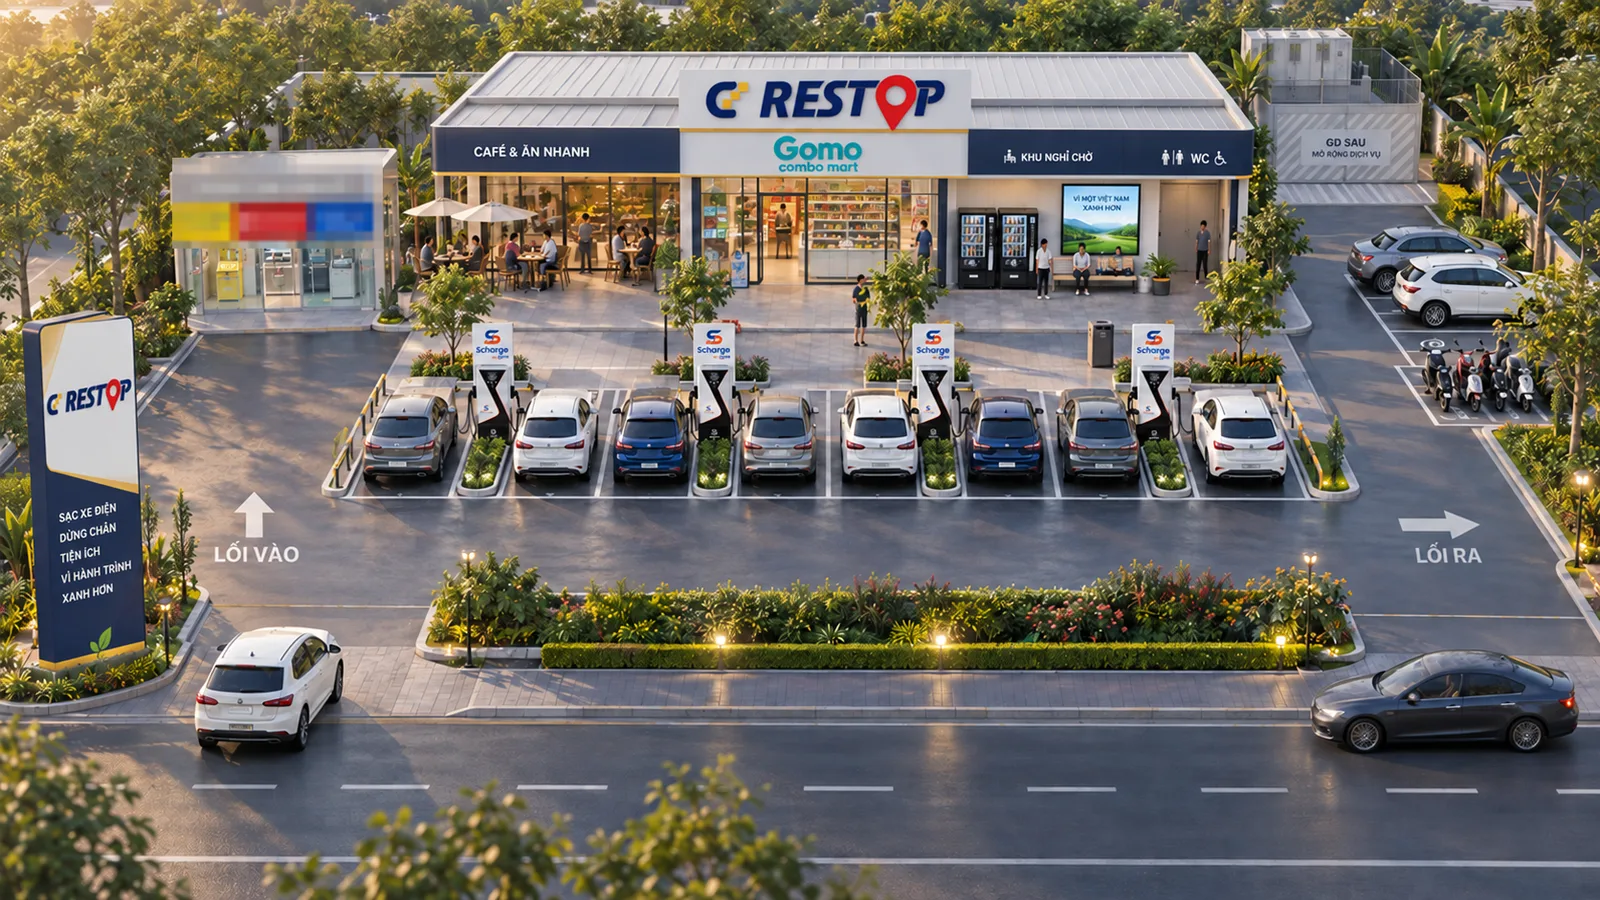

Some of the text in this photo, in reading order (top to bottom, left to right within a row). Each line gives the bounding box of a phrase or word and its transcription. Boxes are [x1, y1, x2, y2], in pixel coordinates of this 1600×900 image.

[760, 75, 945, 131] RESTOP
[474, 144, 590, 157] CAFÉ & ĂN NHANH
[773, 135, 862, 161] Gomo
[1326, 138, 1366, 147] GD SAU
[1021, 153, 1042, 162] KHU
[1071, 150, 1093, 162] CHỜ
[1190, 153, 1210, 164] WC
[1370, 151, 1381, 159] VỤ
[778, 162, 858, 172] combo mart
[65, 378, 132, 412] RESTOP
[59, 502, 117, 523] SẠC XE ĐIỆN
[59, 522, 117, 543] DỪNG CHÂN
[60, 549, 82, 564] TIỆN
[214, 540, 300, 563] LỐI VÀO
[1415, 541, 1483, 563] LỐI RA
[61, 560, 132, 583] VÌ HÀNH TRÌNH
[62, 583, 114, 603] XANH HƠN
